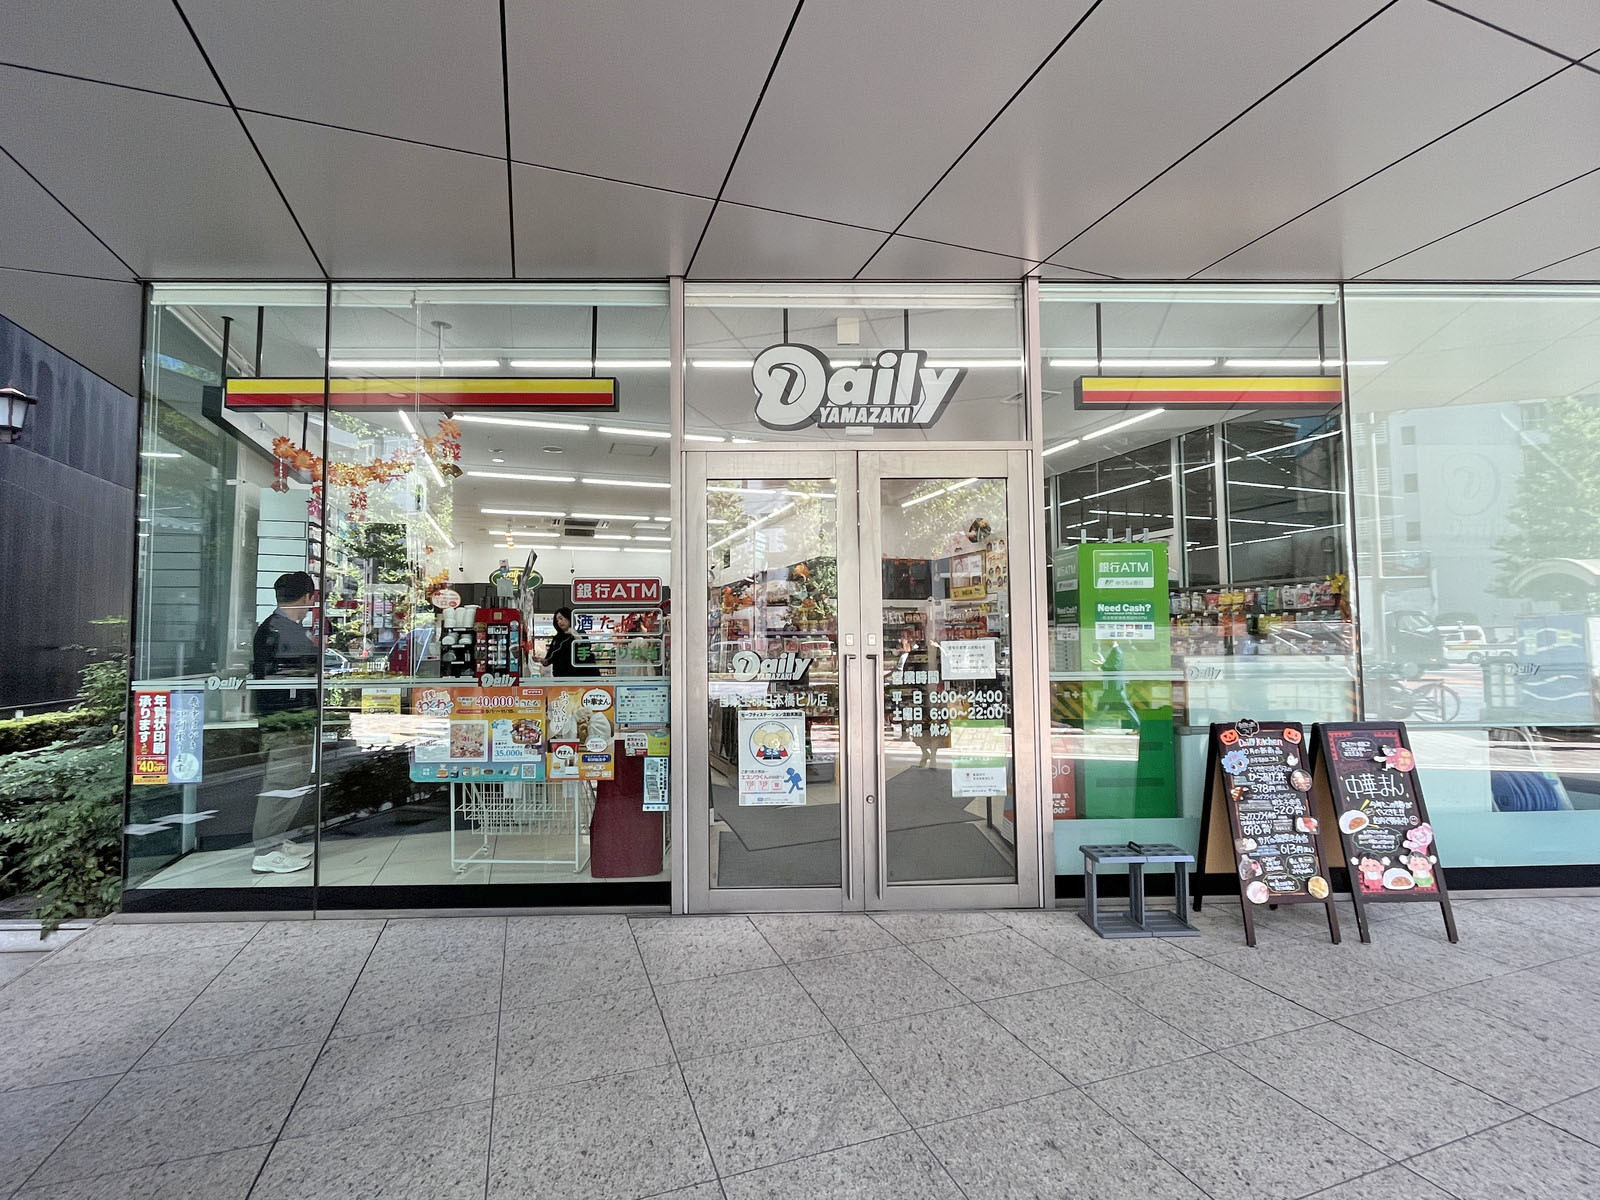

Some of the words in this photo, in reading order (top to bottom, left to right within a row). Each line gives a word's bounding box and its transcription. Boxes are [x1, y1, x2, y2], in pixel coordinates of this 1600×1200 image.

[752, 345, 962, 427] Daily
[820, 407, 911, 424] YAMAZAKI
[1098, 562, 1149, 573] 銀行ATM
[577, 583, 657, 598] 銀行ATM
[1097, 604, 1121, 612] Need
[1122, 604, 1152, 612] Cash?
[577, 615, 594, 634] 酒
[732, 650, 812, 682] Daily
[208, 676, 244, 691] Daily
[481, 673, 517, 688] Daily
[891, 670, 940, 685] 営業時間
[583, 697, 610, 706] 中華まん
[892, 691, 903, 705] 平
[912, 692, 923, 705] 日
[560, 691, 570, 723] ふっくら
[892, 708, 923, 721] 土曜日
[138, 695, 152, 743] 承ります
[153, 695, 167, 755] 年賀状印刷
[930, 724, 951, 737] 休み
[1345, 773, 1404, 799] 中華まん
